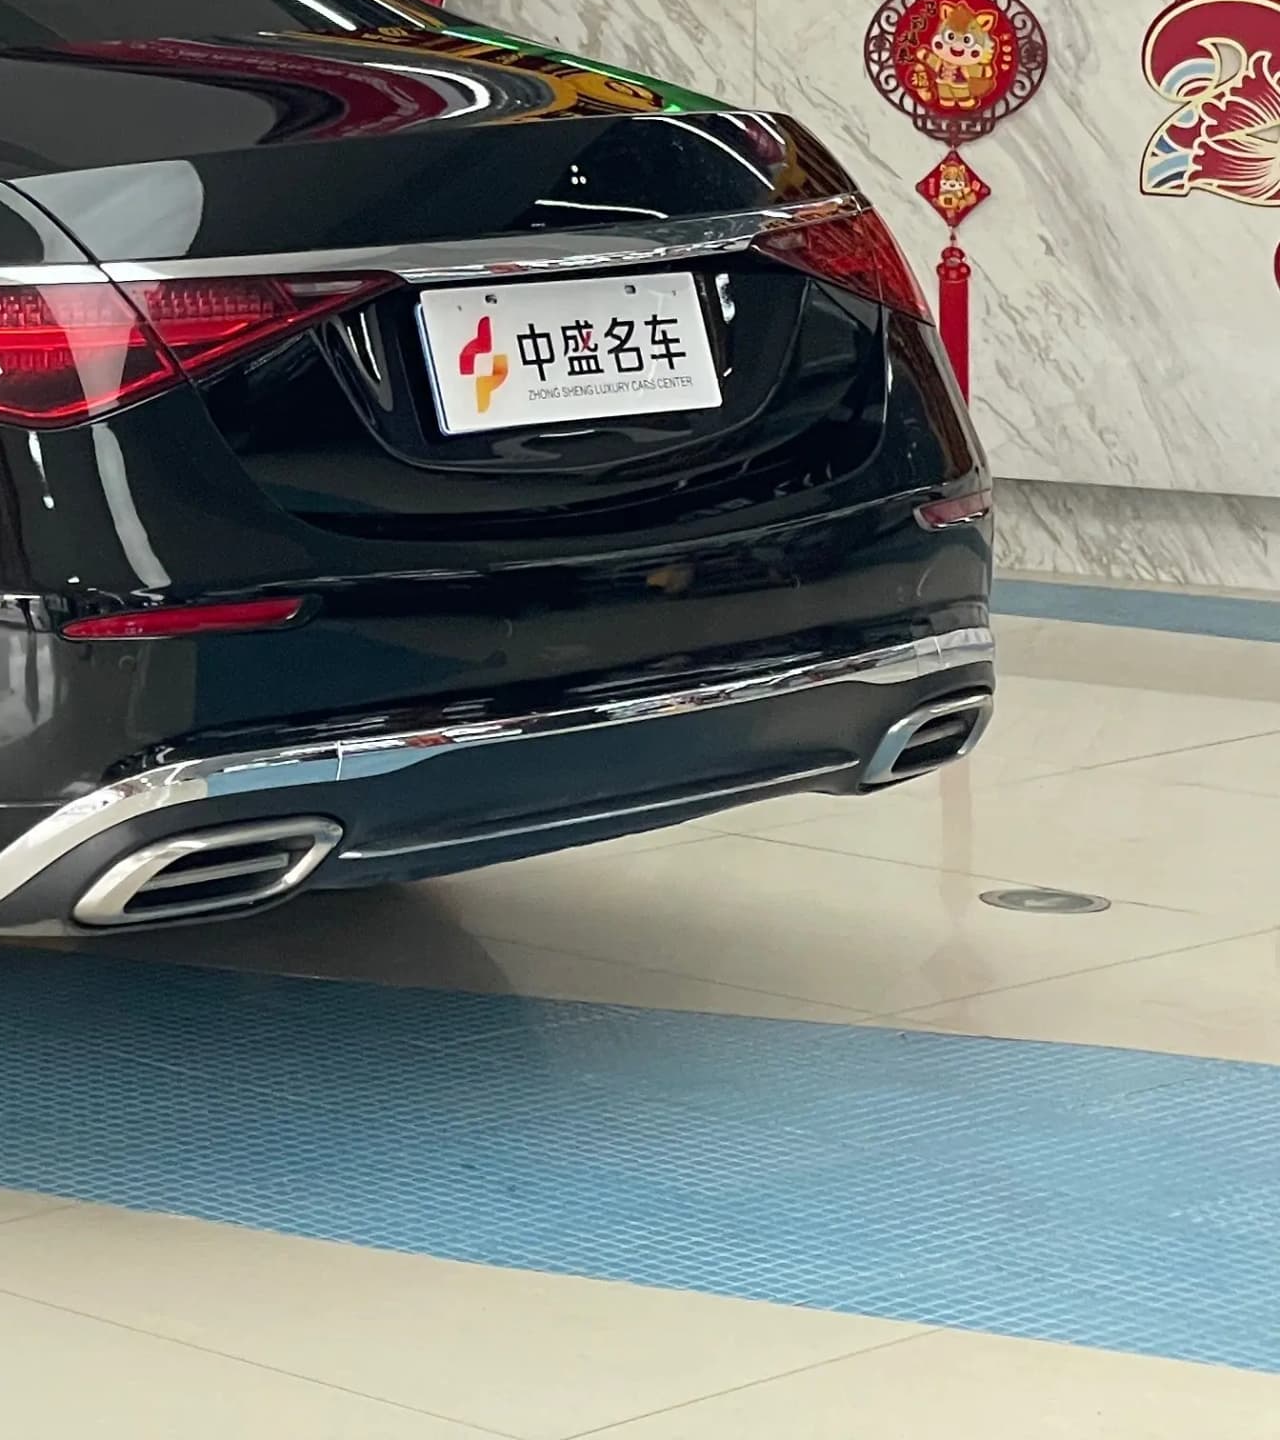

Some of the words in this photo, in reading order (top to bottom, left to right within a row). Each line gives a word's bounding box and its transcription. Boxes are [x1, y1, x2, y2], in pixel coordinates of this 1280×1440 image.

[516, 314, 687, 382] 中盛名车
[528, 387, 561, 401] ZHONG
[562, 384, 594, 398] SHENG
[595, 380, 630, 395] LUXURY
[657, 375, 693, 389] CENTER
